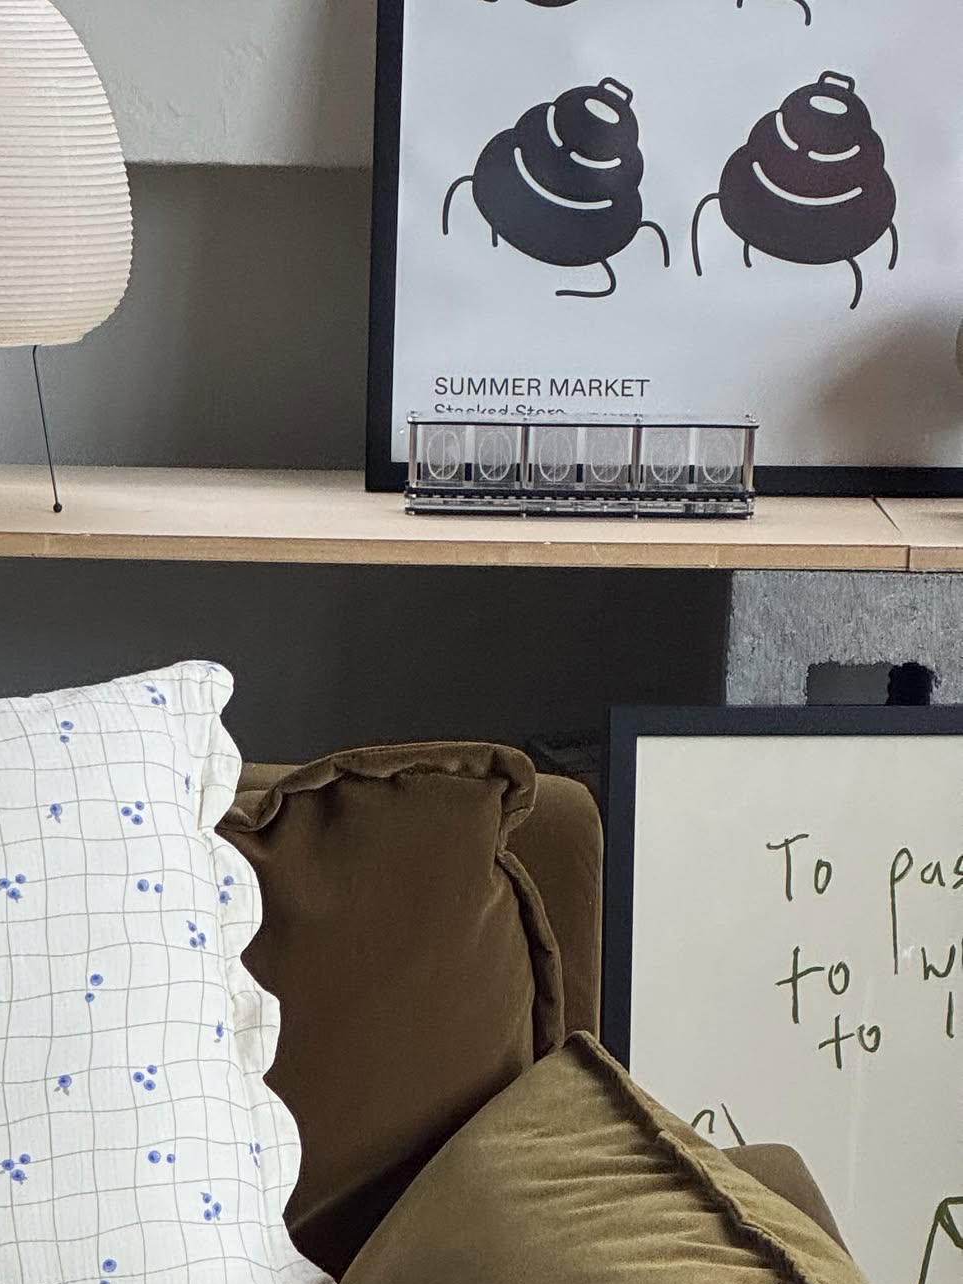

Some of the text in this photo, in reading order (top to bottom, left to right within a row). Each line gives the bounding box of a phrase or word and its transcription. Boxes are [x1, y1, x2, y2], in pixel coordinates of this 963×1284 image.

[434, 376, 651, 397] SUMMER MARKET
[766, 833, 833, 902] To
[774, 945, 851, 1025] to
[817, 1013, 882, 1071] to
